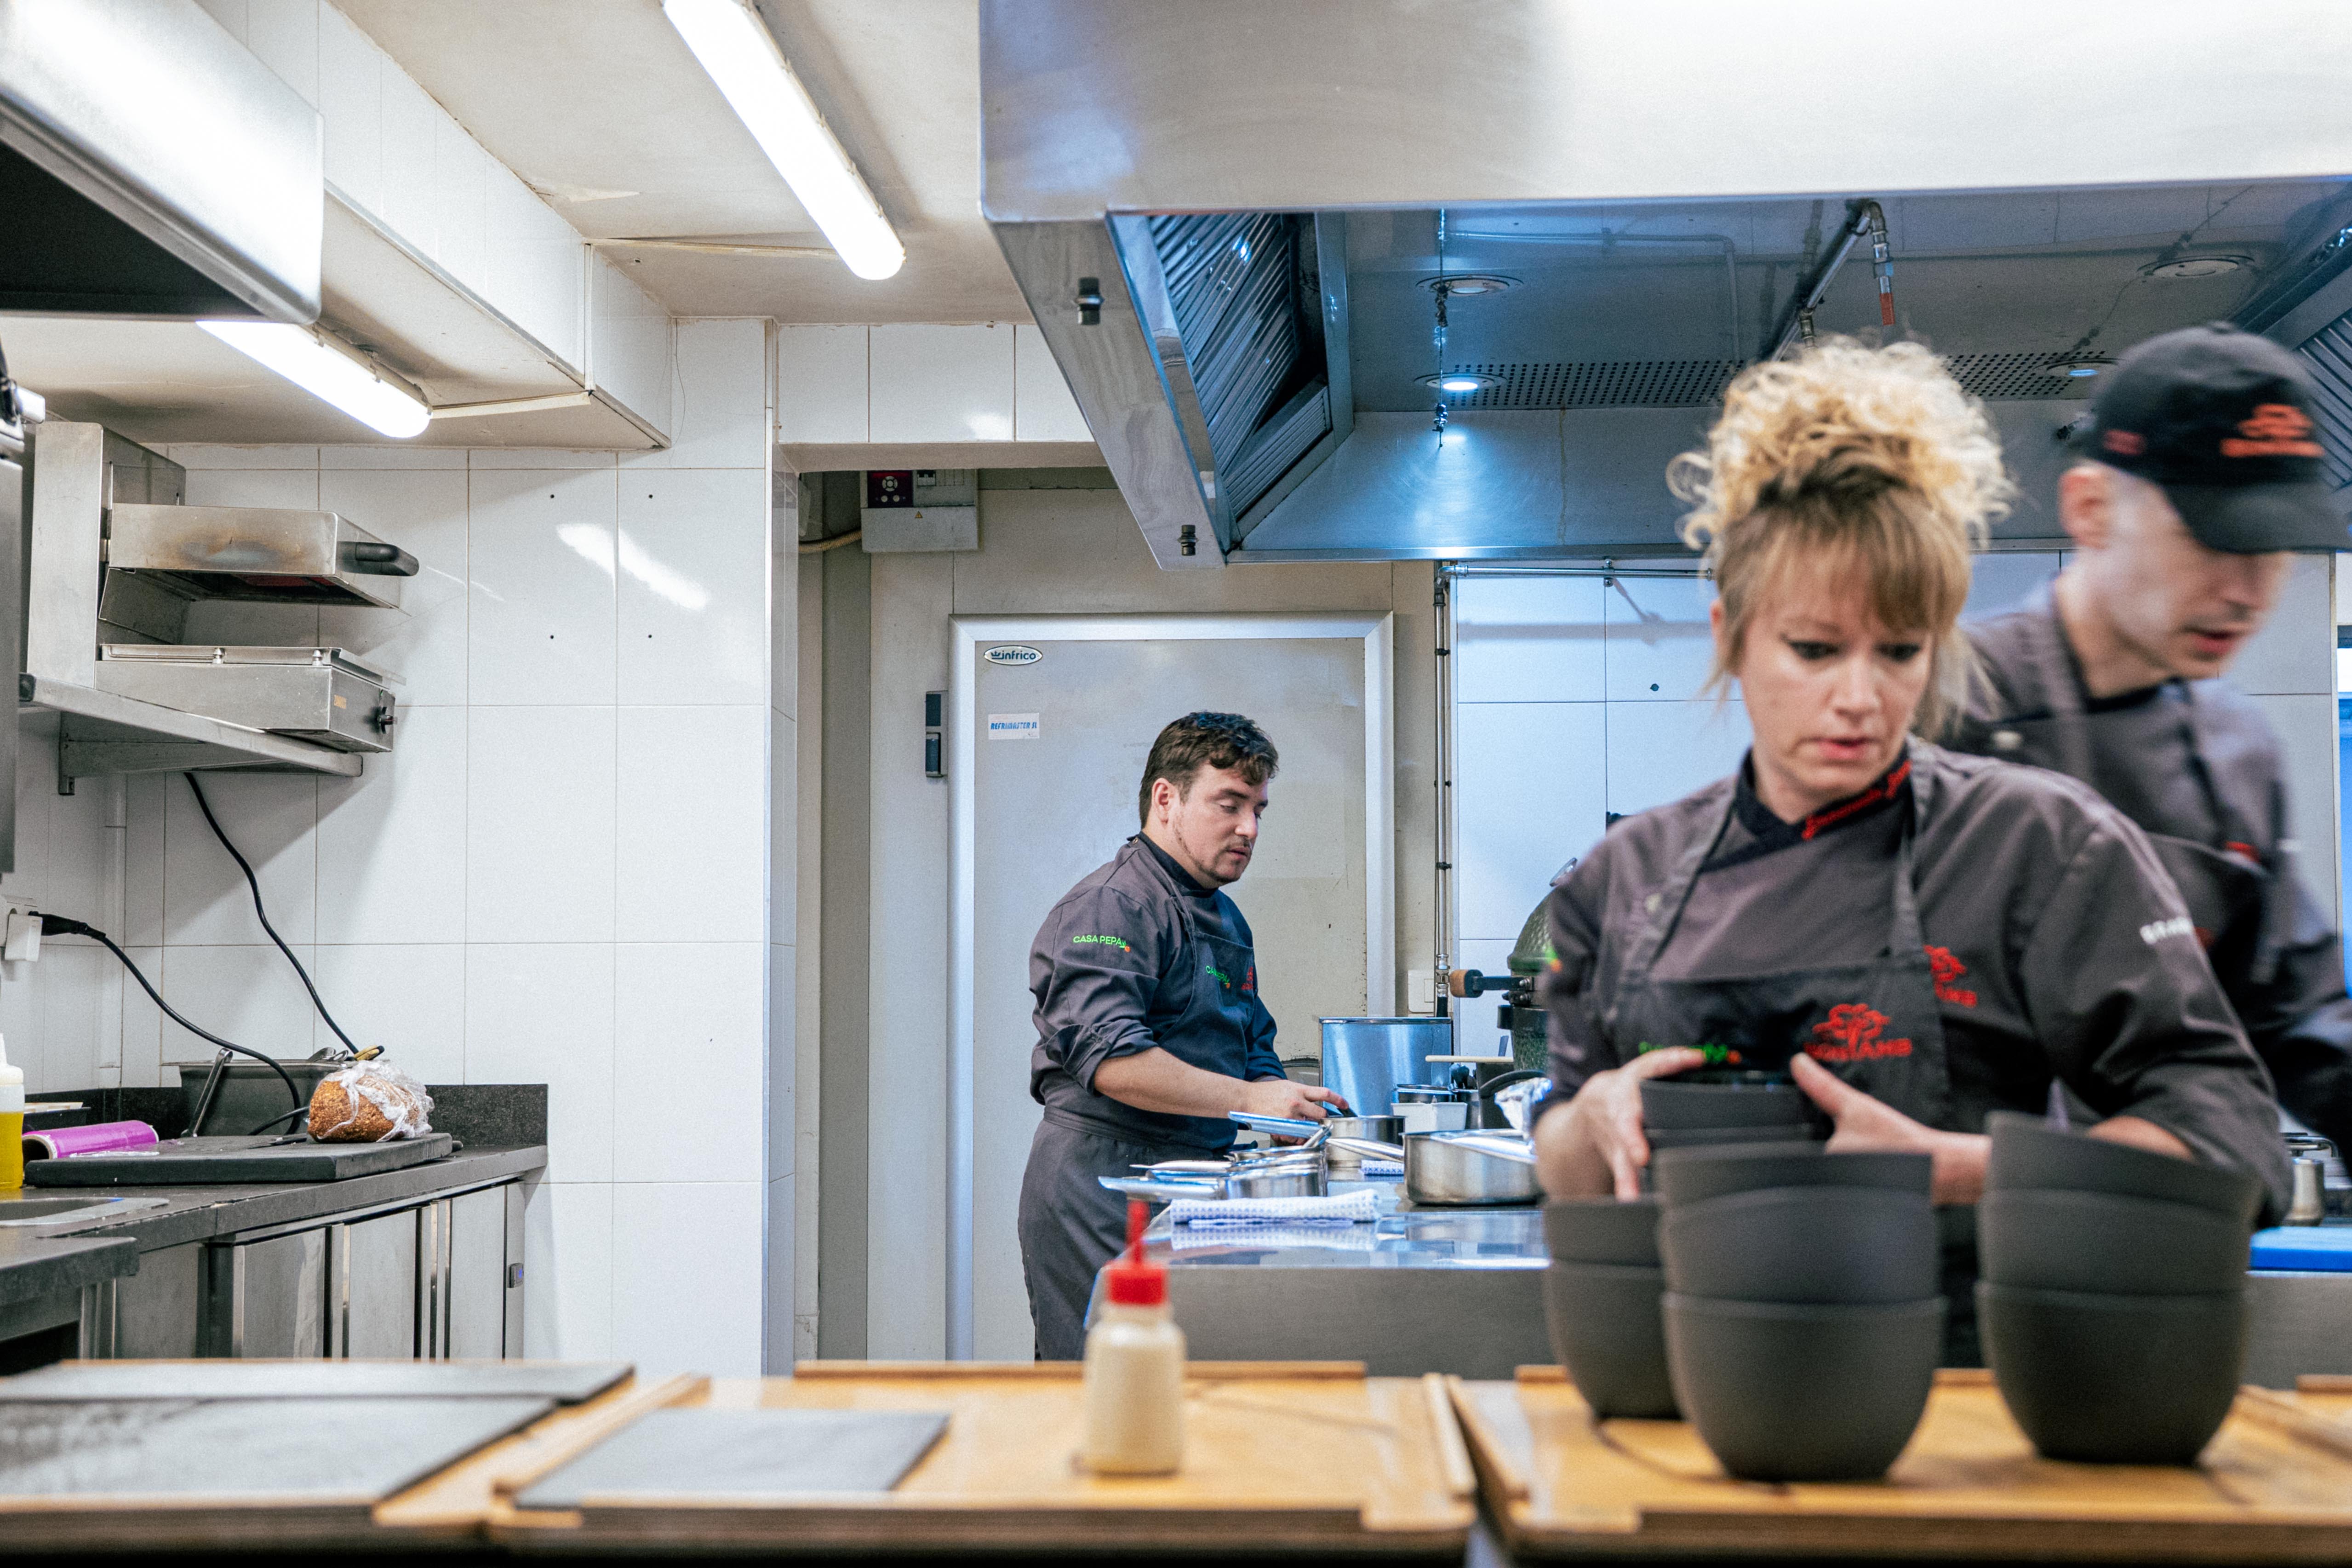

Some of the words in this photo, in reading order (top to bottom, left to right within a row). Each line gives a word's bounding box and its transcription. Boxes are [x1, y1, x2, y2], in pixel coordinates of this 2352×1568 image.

[1001, 650, 1036, 660] infrico
[1073, 934, 1099, 944] CASA
[1099, 935, 1122, 945] PEPA
